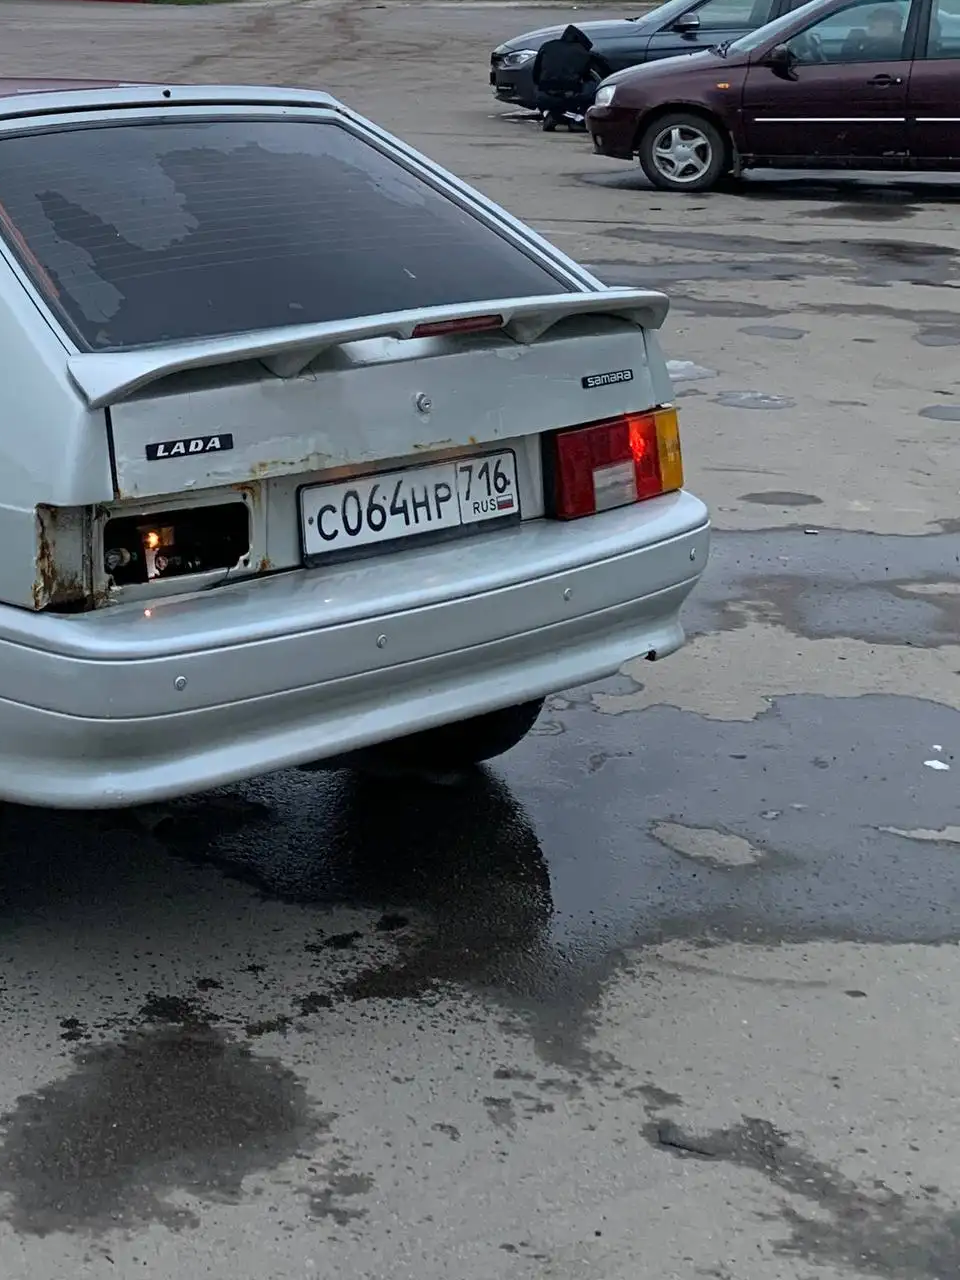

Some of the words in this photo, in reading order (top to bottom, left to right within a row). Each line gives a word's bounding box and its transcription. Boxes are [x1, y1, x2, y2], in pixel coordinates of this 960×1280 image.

[156, 436, 221, 457] LADA
[316, 479, 452, 542] С064НР
[459, 459, 508, 501] 716
[472, 498, 497, 515] RUS
